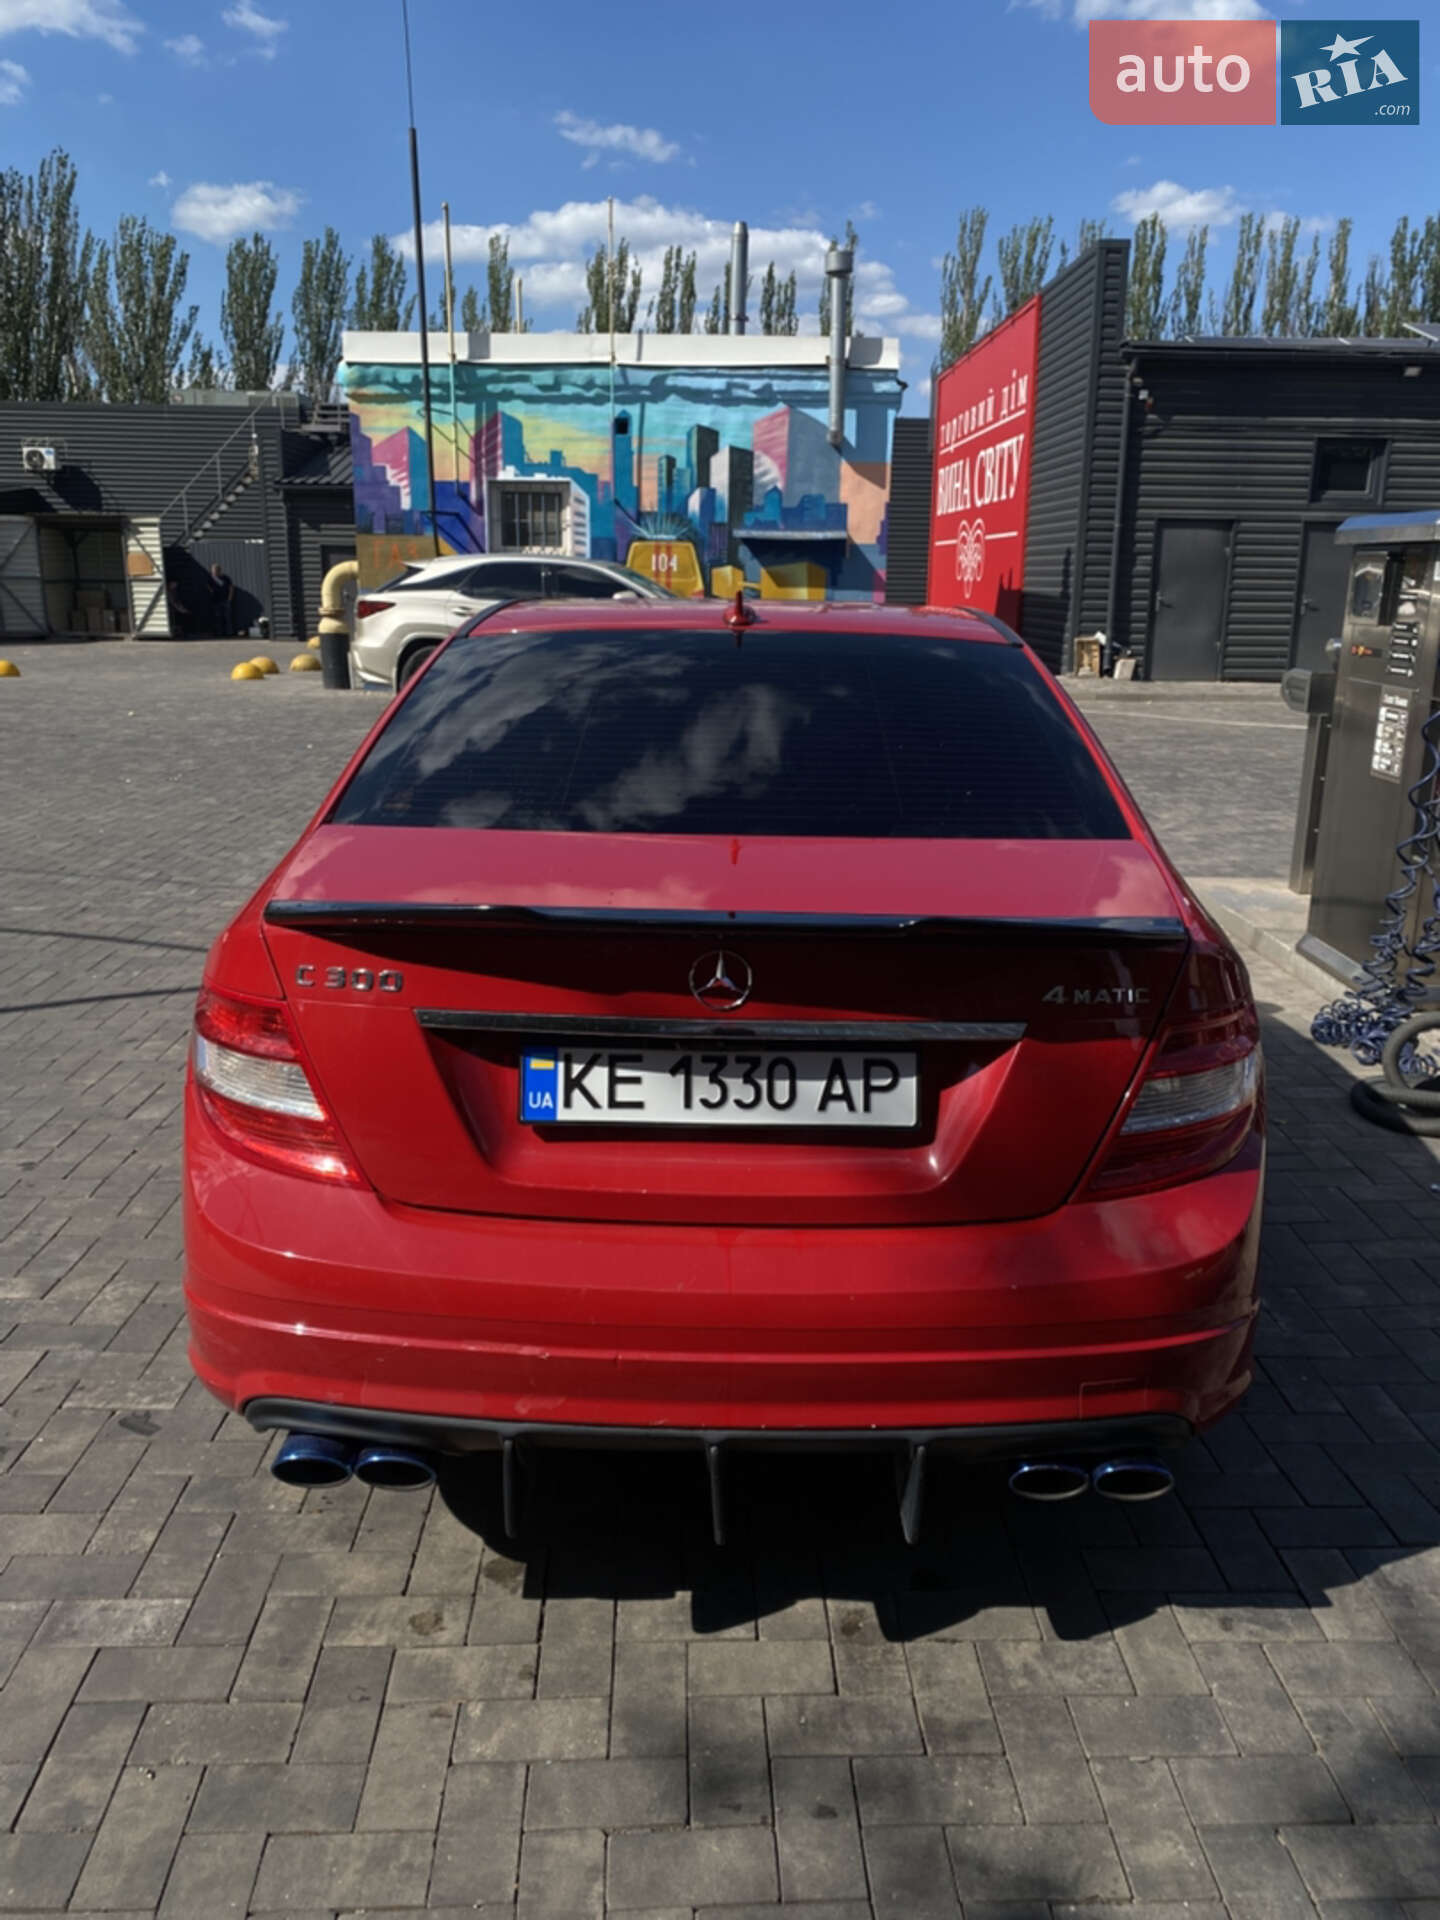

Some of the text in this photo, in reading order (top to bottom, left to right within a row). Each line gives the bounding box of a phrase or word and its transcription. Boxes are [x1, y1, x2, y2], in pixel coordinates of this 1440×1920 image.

[936, 433, 1024, 516] ВИНА СВІТУ
[651, 553, 678, 572] 104
[296, 964, 404, 992] C 300
[562, 1053, 900, 1114] KE 1330 AP
[528, 1091, 554, 1109] UA
